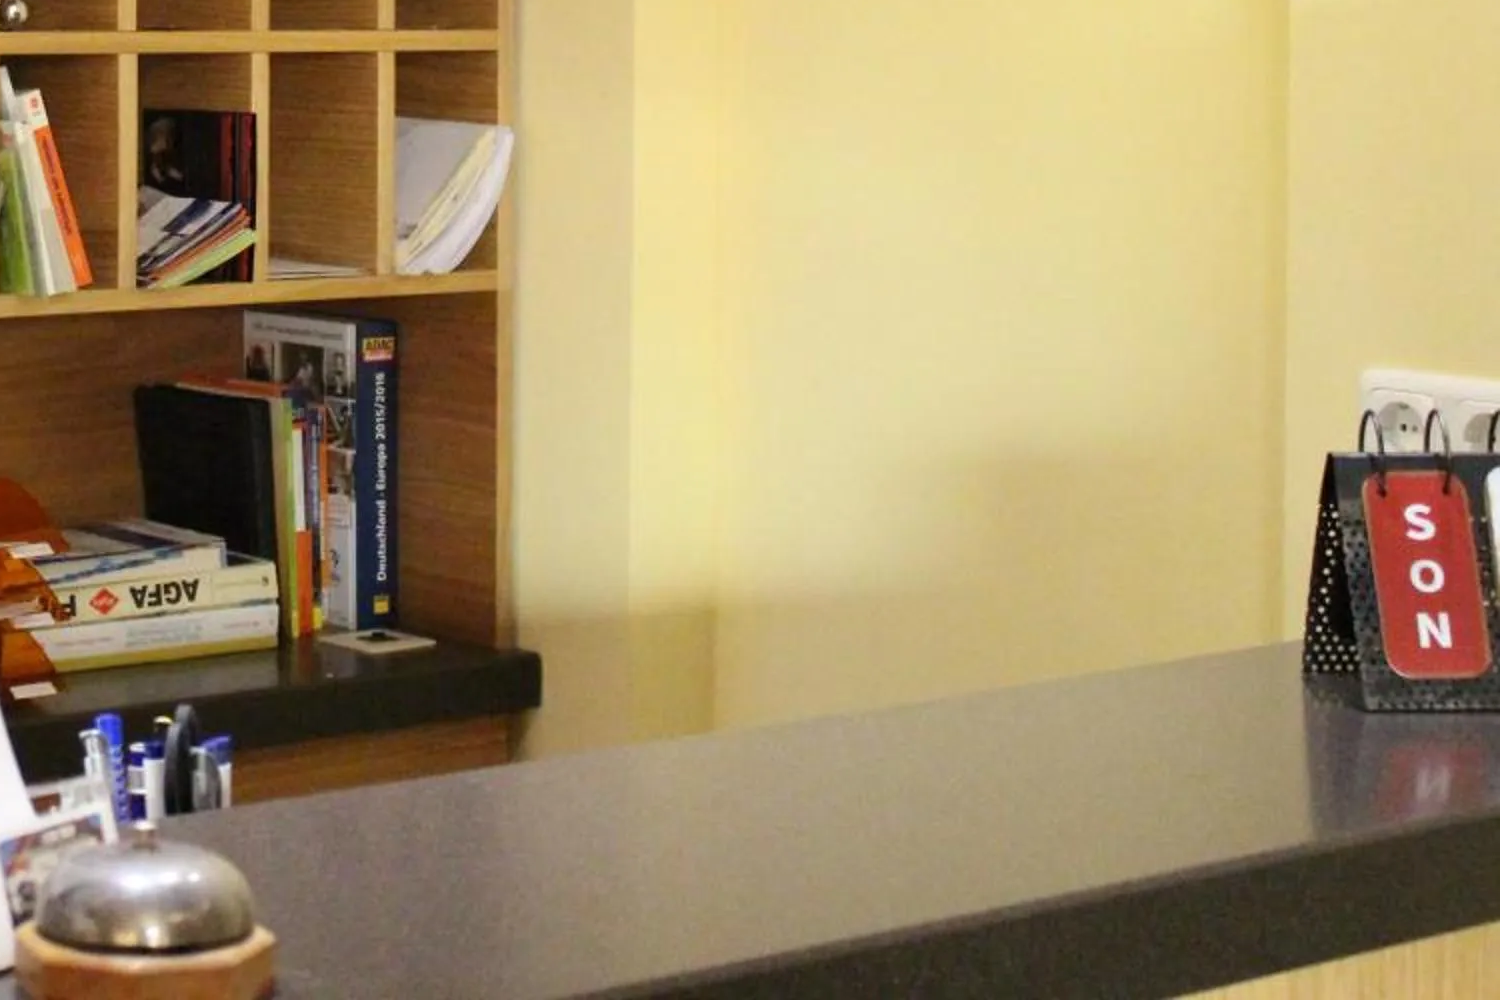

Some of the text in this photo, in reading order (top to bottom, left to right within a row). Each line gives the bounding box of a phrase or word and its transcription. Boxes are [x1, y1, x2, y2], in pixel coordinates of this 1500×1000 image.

[373, 371, 386, 440] 2015/2016
[375, 443, 387, 491] Europa
[375, 499, 387, 581] Deutschland
[129, 578, 200, 609] AGFA
